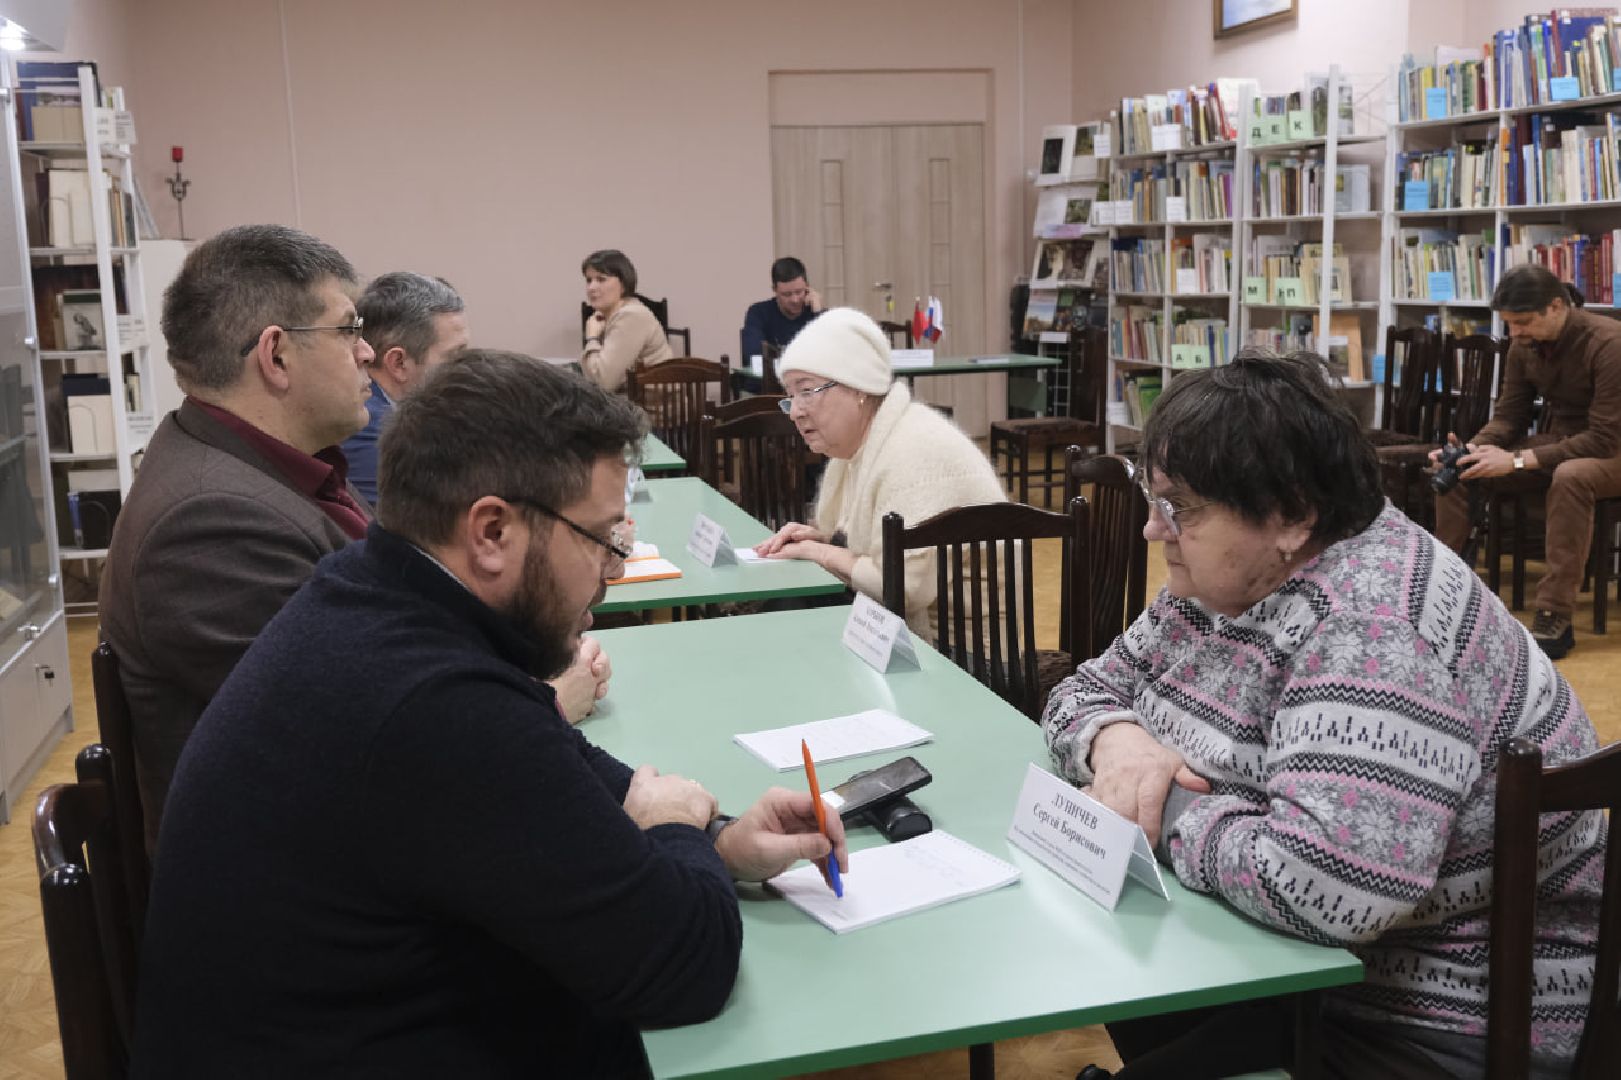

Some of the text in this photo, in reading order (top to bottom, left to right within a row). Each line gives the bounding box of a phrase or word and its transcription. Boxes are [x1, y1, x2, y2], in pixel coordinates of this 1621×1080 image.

[1294, 121, 1302, 131] К
[1248, 286, 1257, 295] М
[1034, 802, 1060, 829] Сергей
[1061, 820, 1106, 859] Борисович
